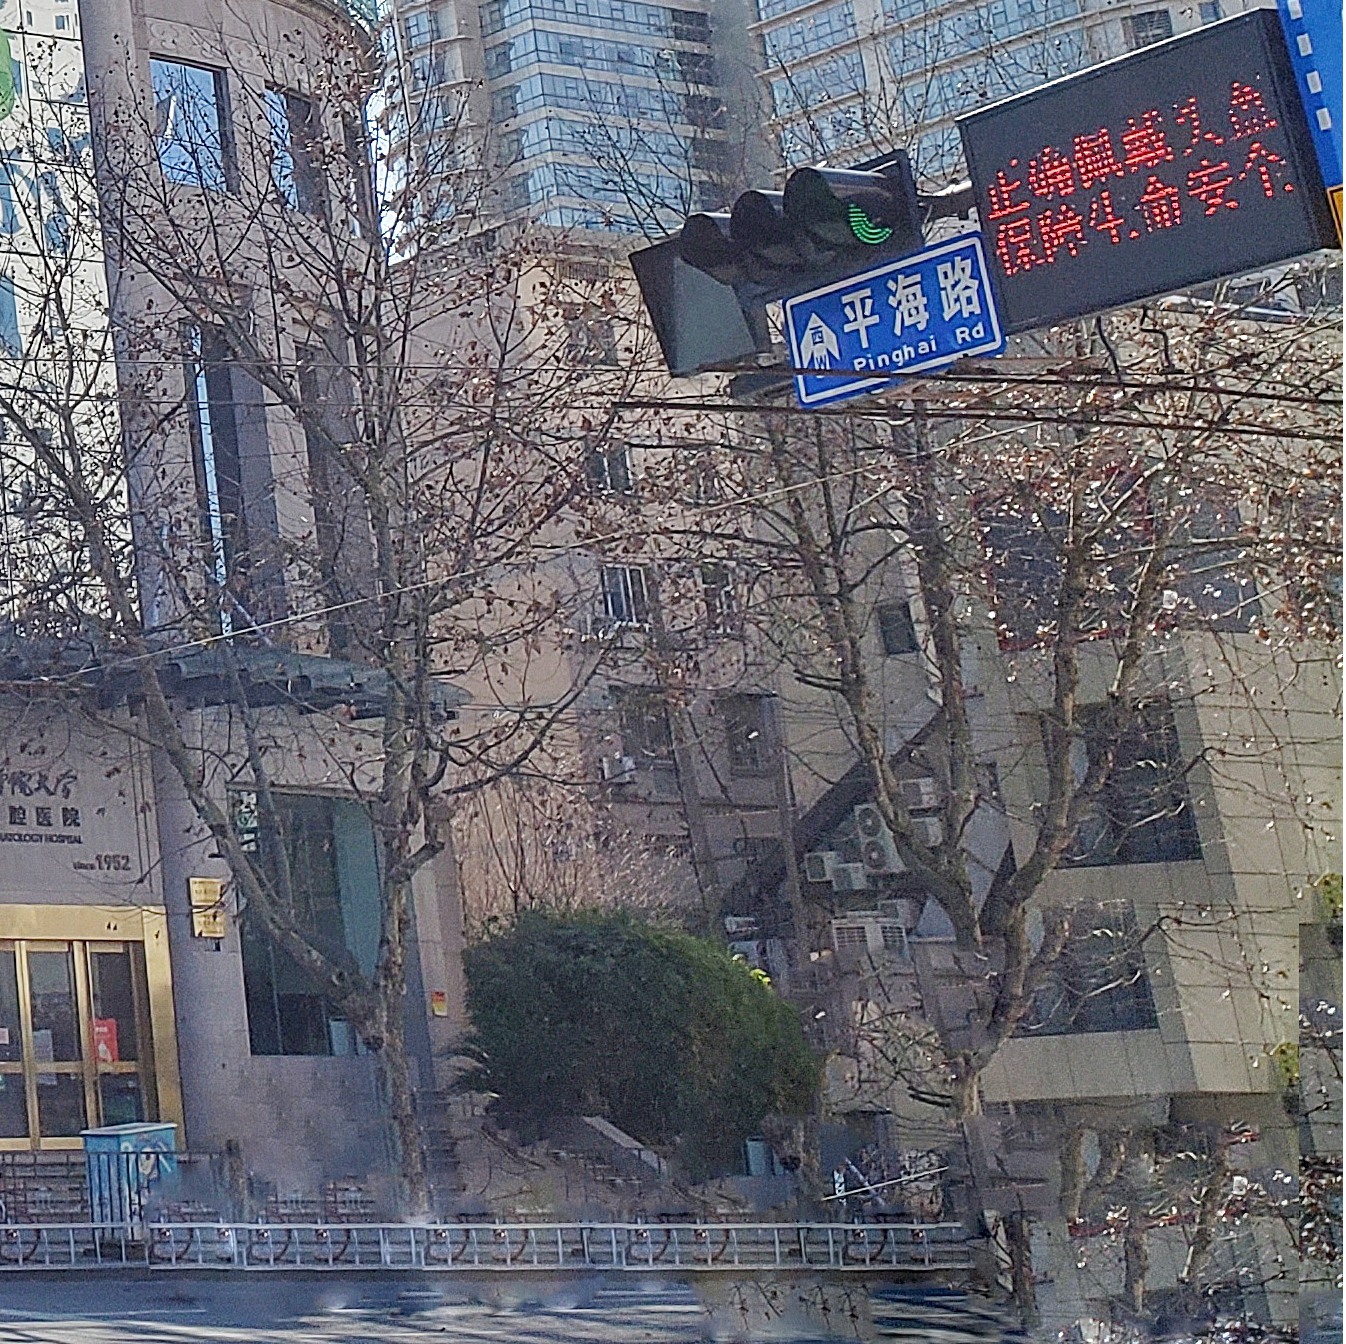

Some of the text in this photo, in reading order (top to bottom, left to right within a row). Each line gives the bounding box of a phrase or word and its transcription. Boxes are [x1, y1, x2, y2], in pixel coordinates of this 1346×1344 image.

[841, 256, 982, 349] 平海路
[853, 322, 985, 372] Pinghai Rd
[44, 833, 83, 844] HOSPITAL
[95, 854, 131, 870] 1952
